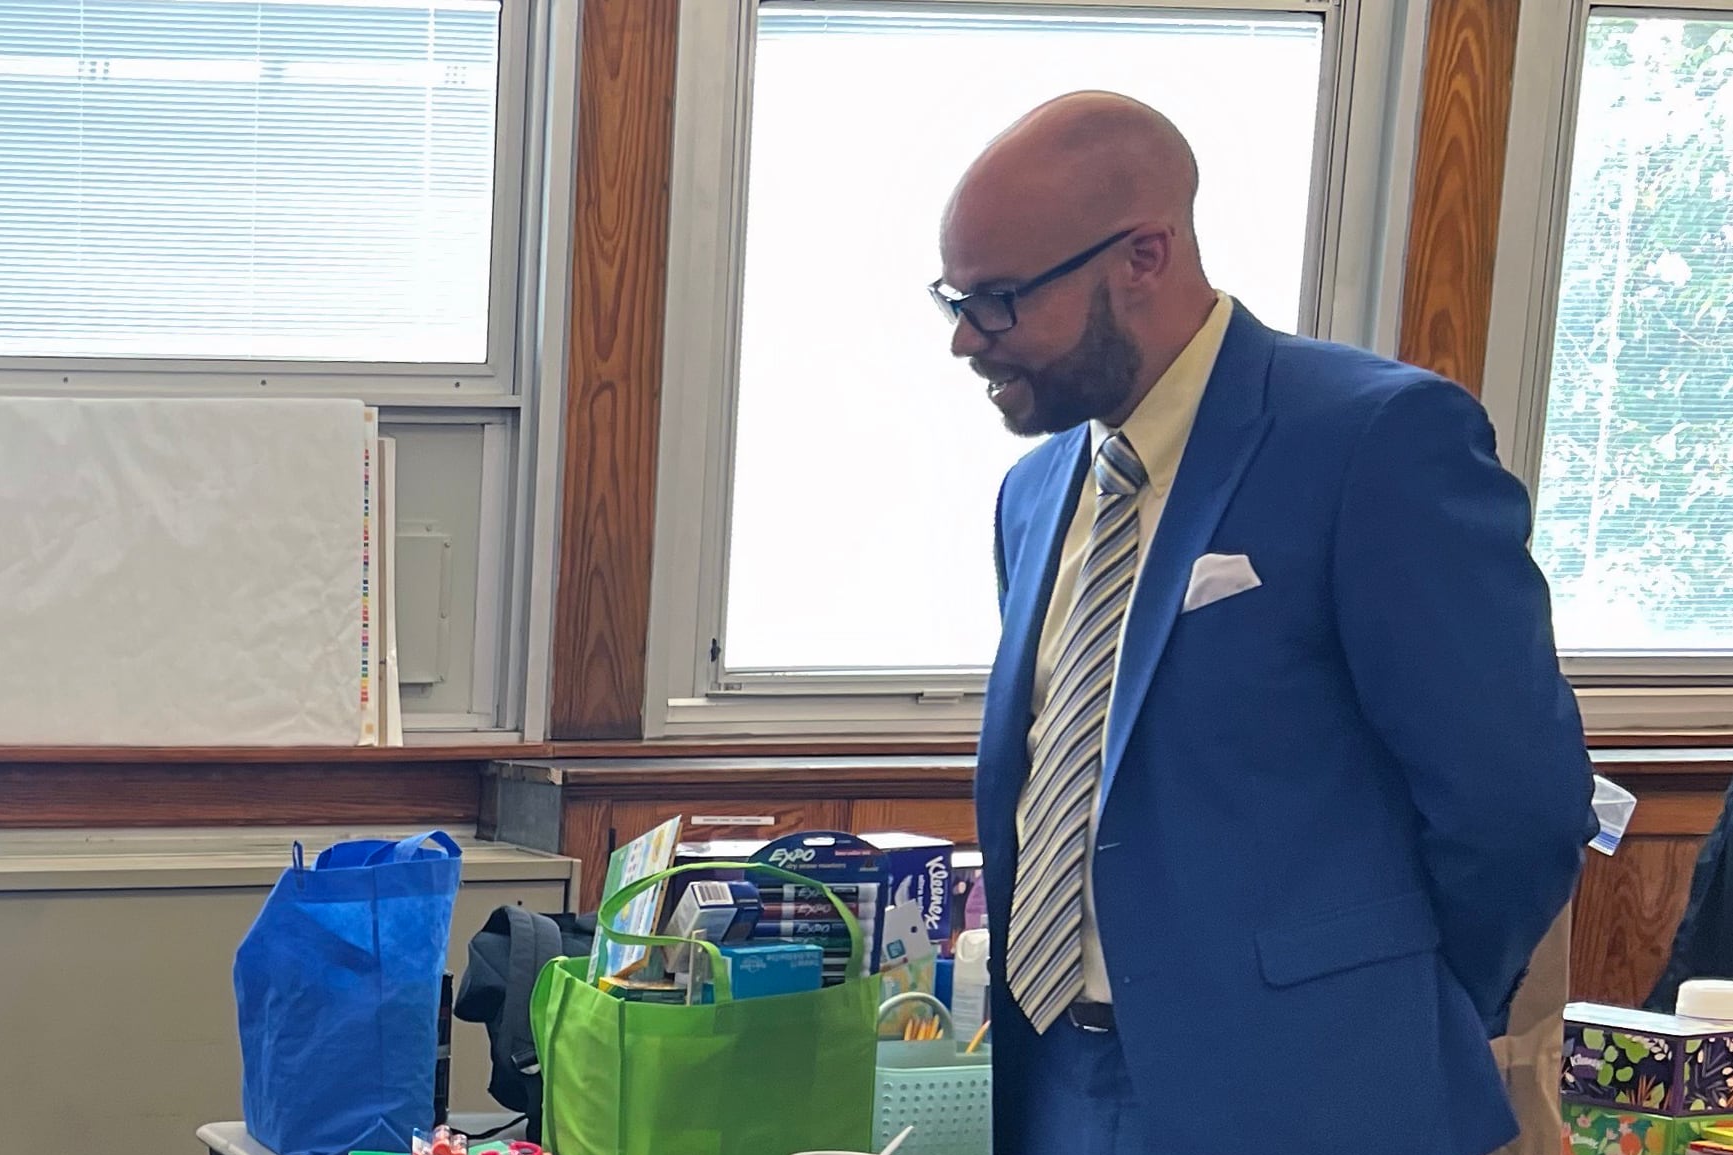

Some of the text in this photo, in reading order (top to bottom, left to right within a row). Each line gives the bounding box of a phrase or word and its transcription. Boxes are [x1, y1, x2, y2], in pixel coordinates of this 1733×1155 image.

[768, 848, 816, 867] EXPO
[924, 855, 949, 930] Kleenex
[796, 904, 832, 916] EXPO
[796, 923, 831, 935] EXPO
